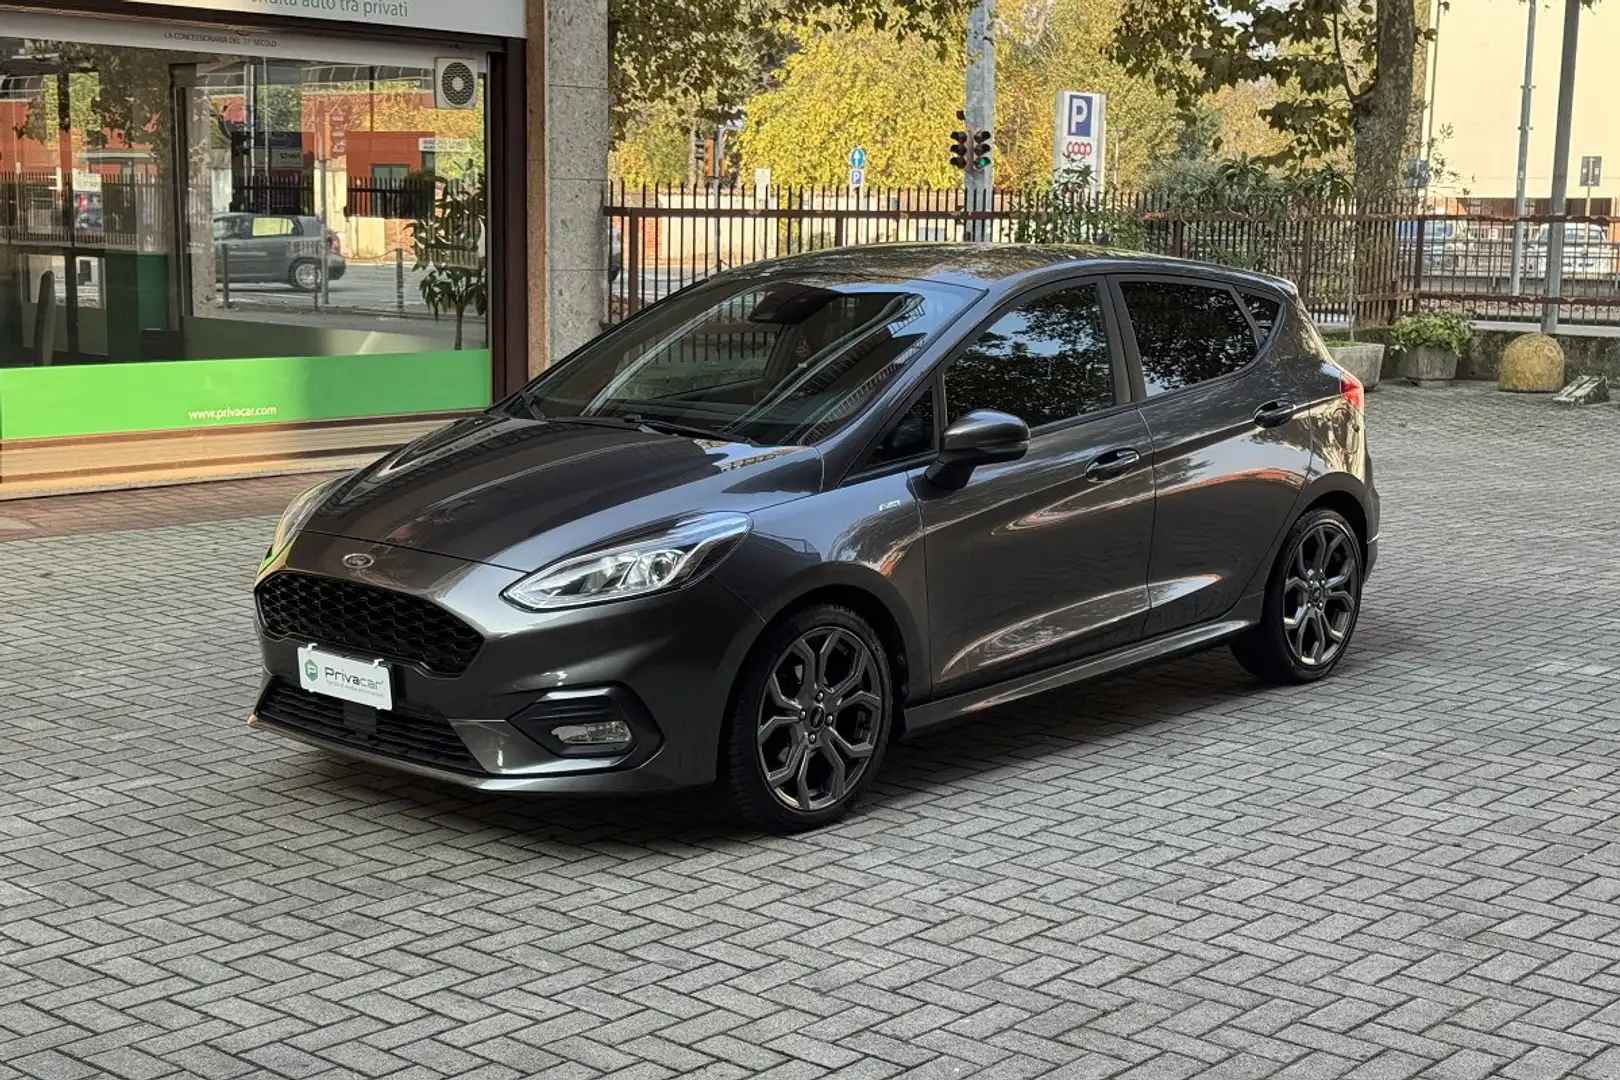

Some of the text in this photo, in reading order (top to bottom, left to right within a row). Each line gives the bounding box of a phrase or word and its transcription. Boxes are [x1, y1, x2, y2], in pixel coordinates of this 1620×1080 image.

[302, 0, 336, 10] auto
[340, 0, 359, 12] tra
[363, 1, 408, 17] privati
[1070, 98, 1088, 134] P
[188, 406, 277, 420] www.privacar.com
[324, 666, 384, 690] Privacar
